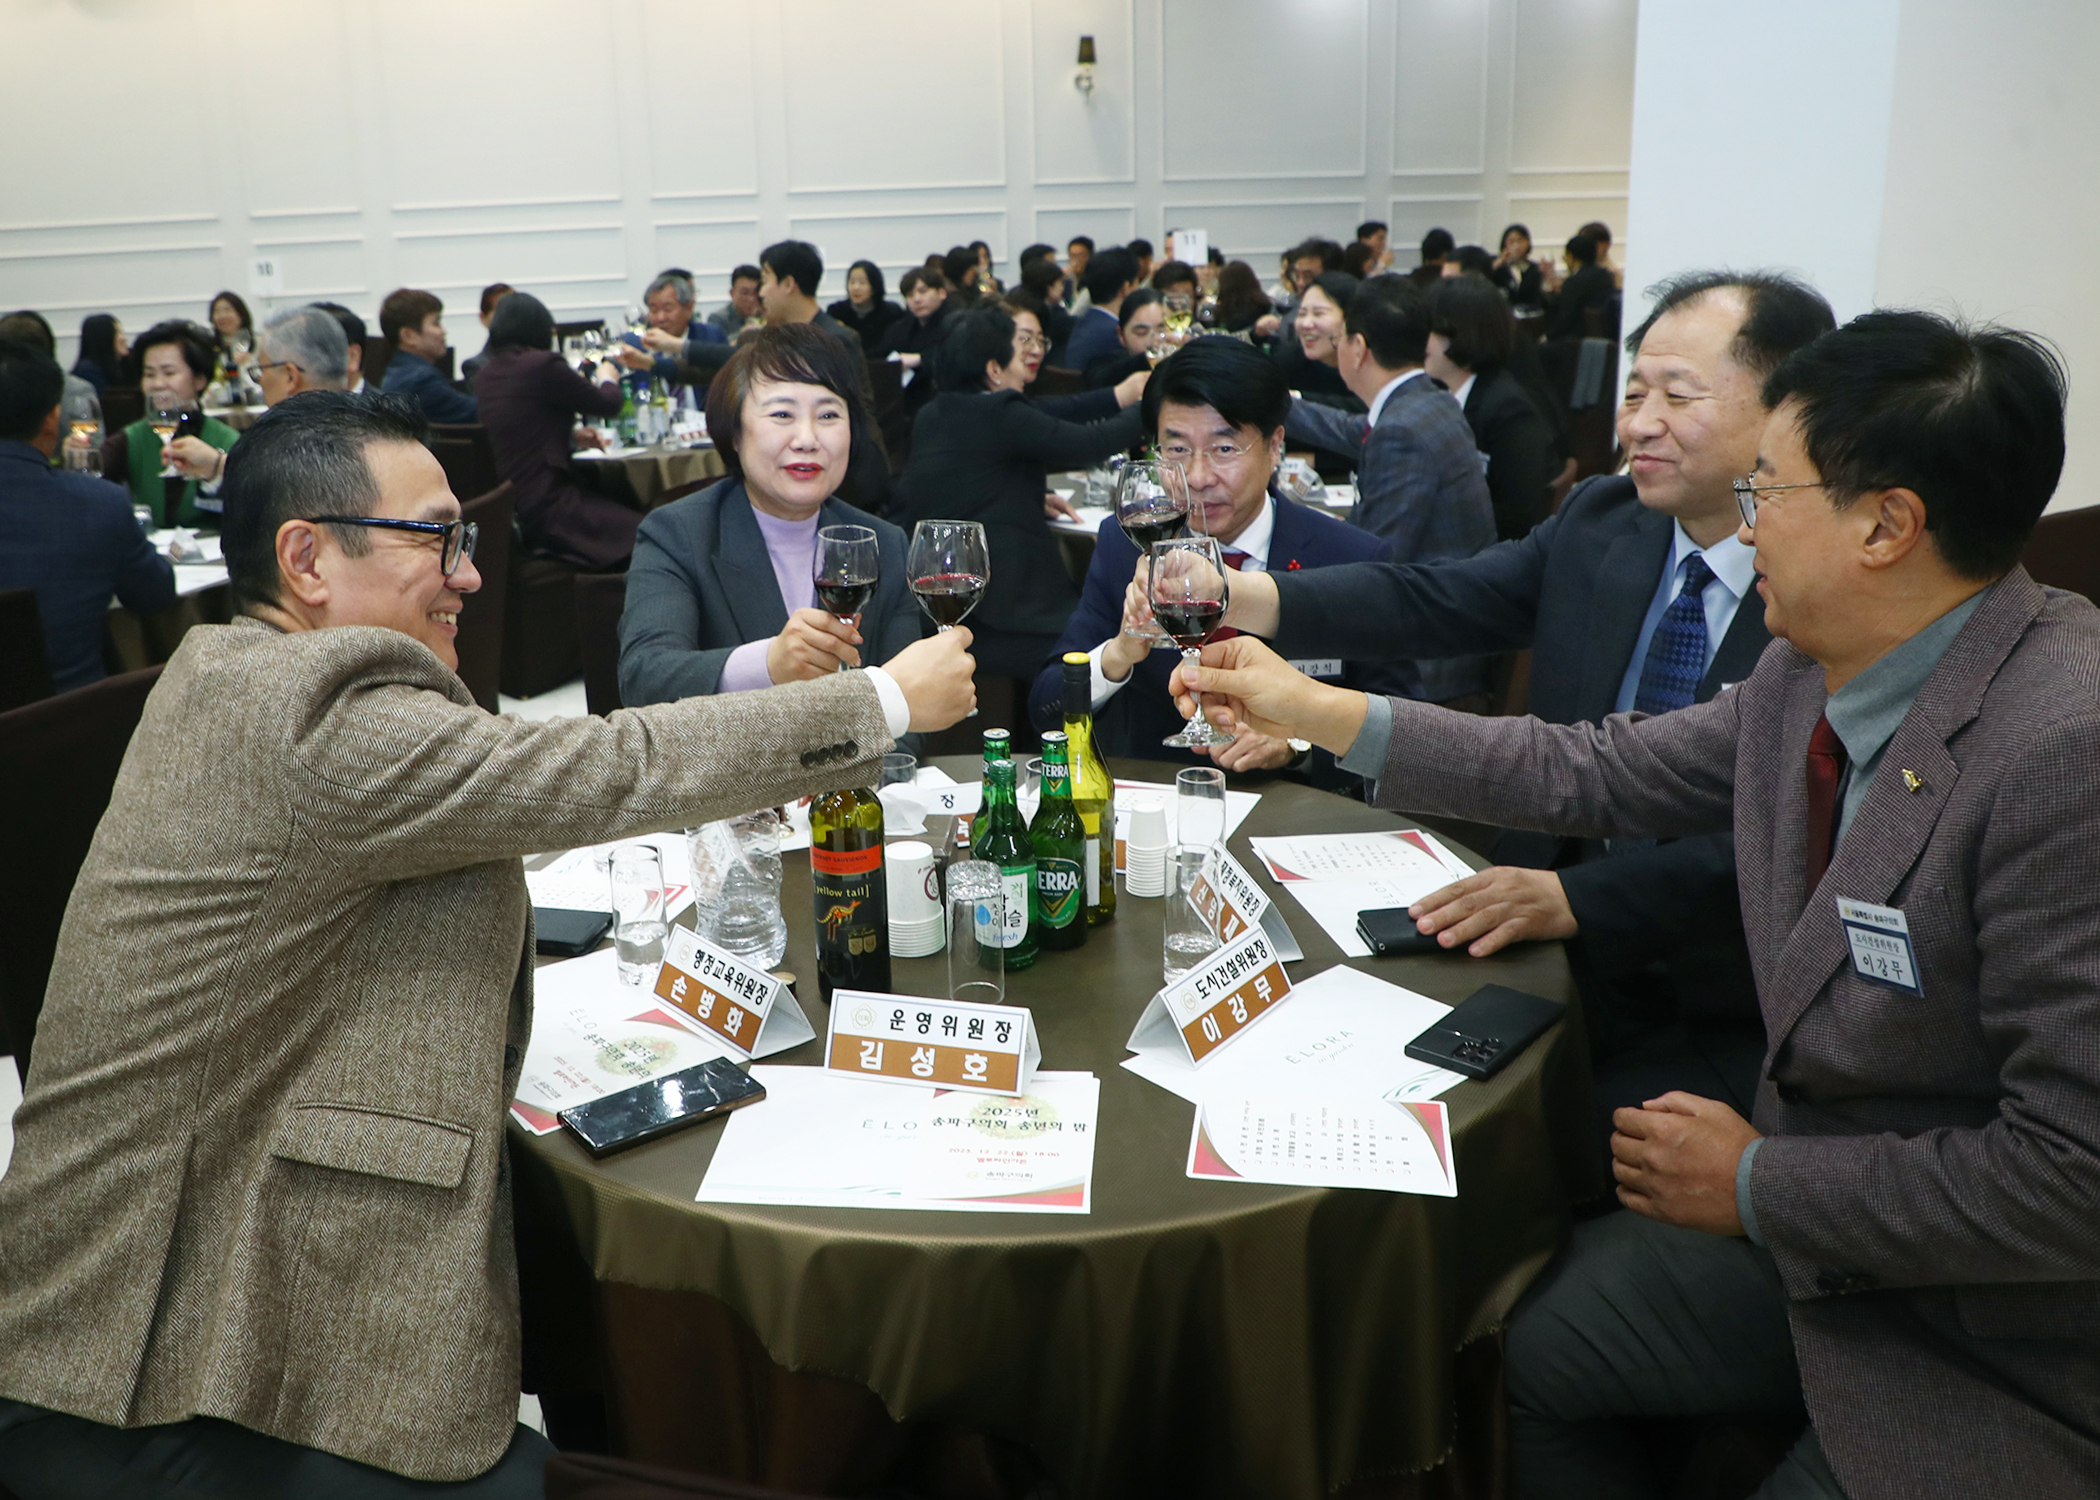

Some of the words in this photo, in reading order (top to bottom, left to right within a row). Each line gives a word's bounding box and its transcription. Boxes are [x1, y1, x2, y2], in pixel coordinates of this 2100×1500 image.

[1042, 763, 1069, 777] TERRA
[1037, 870, 1079, 890] ERRA
[693, 949, 768, 1006] 행정교육위원장
[1195, 940, 1268, 1000] 도시건설위원장
[1862, 953, 1904, 980] 이강무
[889, 1009, 1012, 1043] 운영위원장
[982, 1107, 1039, 1118] 2025년
[932, 1117, 1008, 1130] 송파구의회
[1019, 1121, 1063, 1132] 송년의
[1073, 1122, 1089, 1133] 밤
